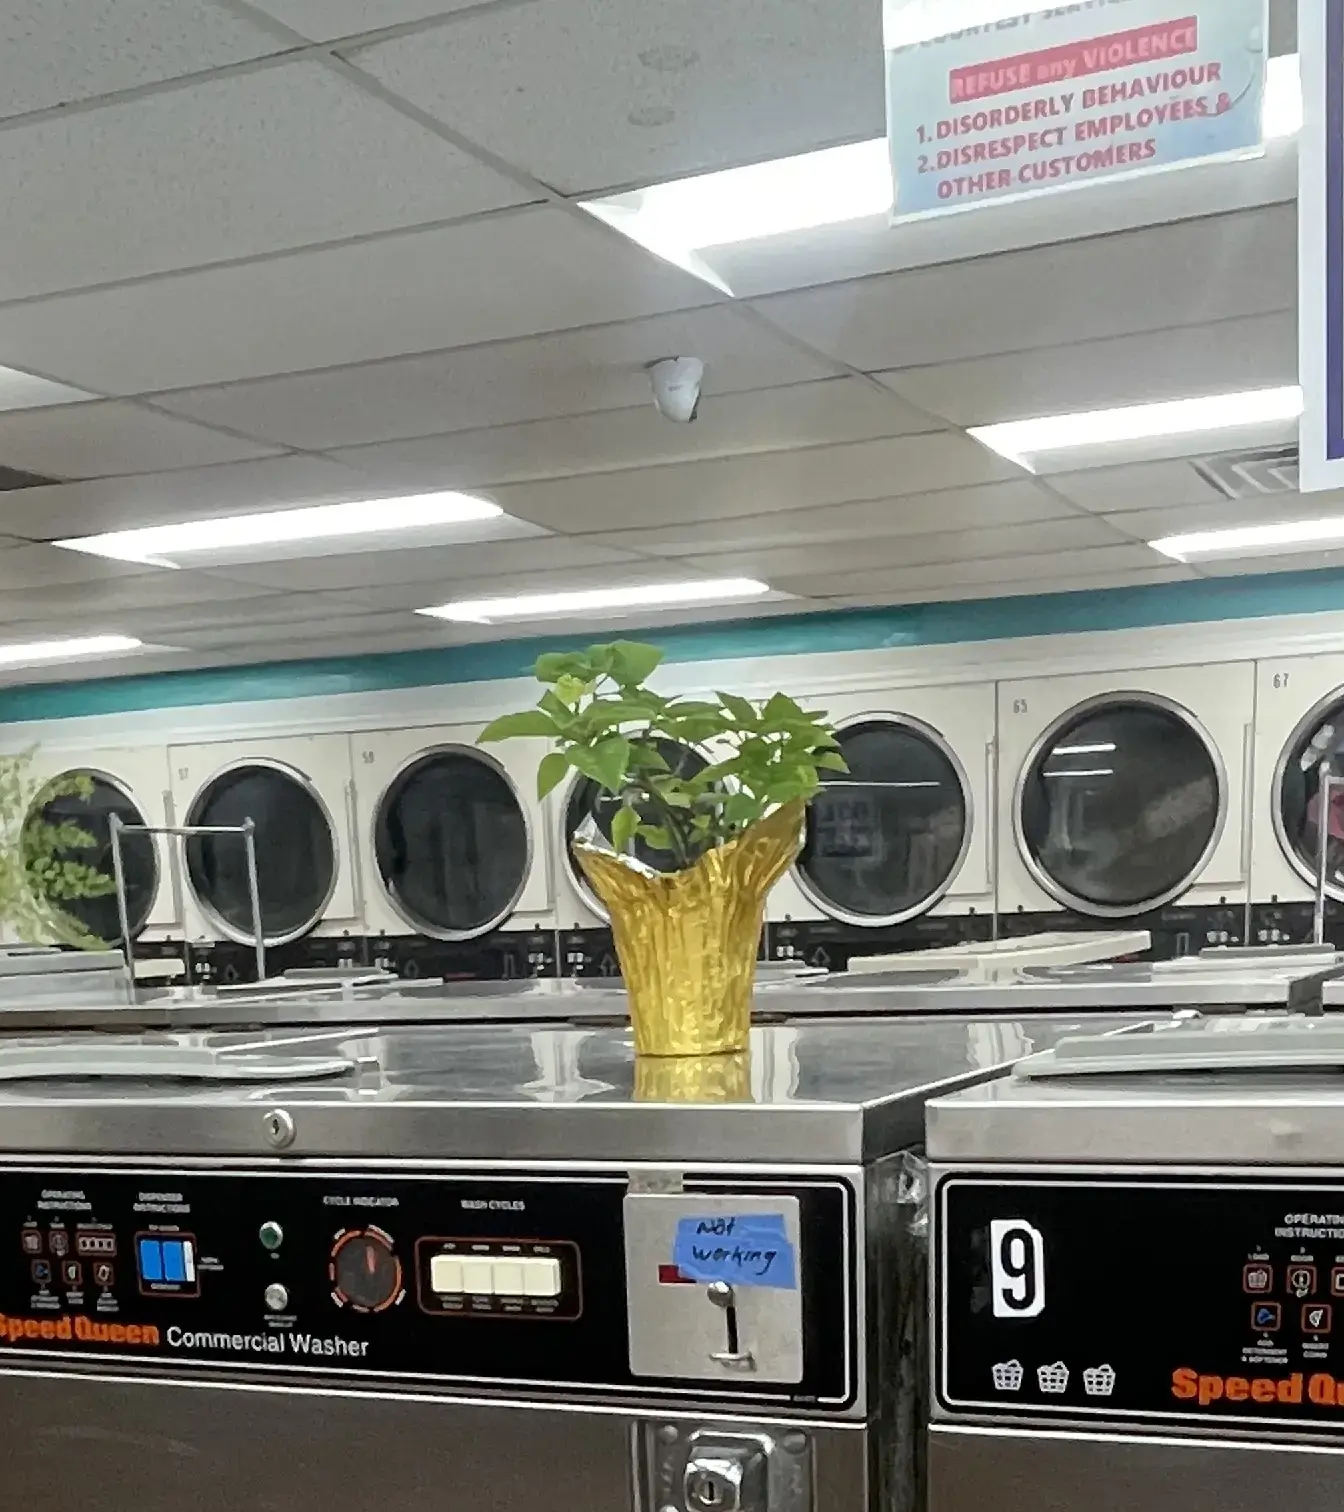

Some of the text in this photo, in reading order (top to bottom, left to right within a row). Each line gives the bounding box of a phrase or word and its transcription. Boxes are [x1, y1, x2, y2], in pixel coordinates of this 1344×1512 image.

[952, 62, 1030, 98] REFUSE
[1037, 56, 1077, 82] any
[937, 93, 1075, 140] DISORDERLY
[1082, 62, 1222, 109] BEHAVIOUR
[937, 127, 1068, 170] DISRESPECT
[1074, 97, 1209, 142] EMPLOYEES
[937, 138, 1157, 200] OTHER CUSTOMERS
[1273, 673, 1289, 689] 67
[1013, 699, 1028, 714] 65
[166, 1325, 284, 1353] Commercial
[289, 1333, 369, 1357] Washer
[1171, 1367, 1303, 1407] Speed
